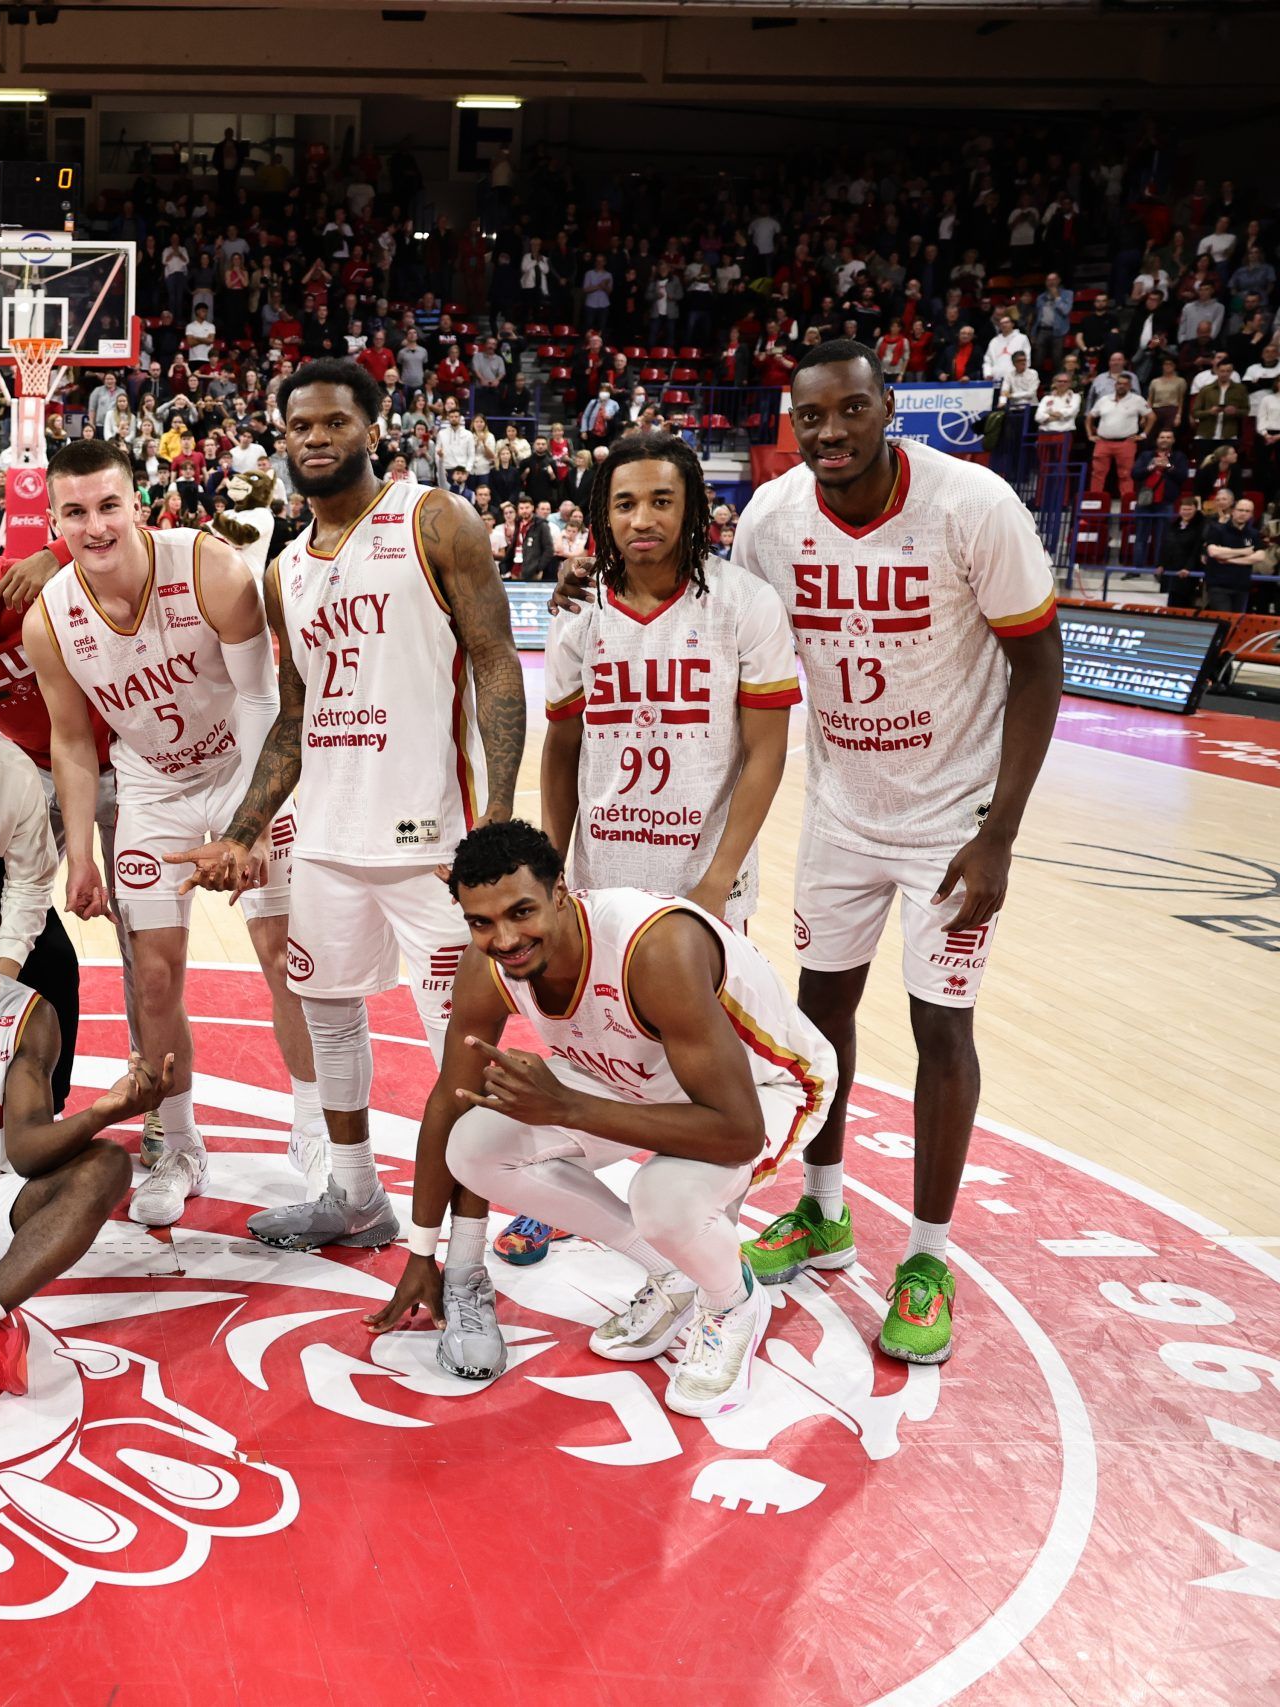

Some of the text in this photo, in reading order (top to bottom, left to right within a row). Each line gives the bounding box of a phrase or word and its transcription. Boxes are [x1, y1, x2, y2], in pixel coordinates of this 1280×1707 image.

[58, 168, 73, 189] 0
[895, 395, 963, 409] utuelles
[792, 564, 930, 611] SLUC
[69, 617, 89, 628] errea
[73, 636, 96, 648] CRÉA
[76, 644, 98, 655] STONE
[93, 651, 199, 713] NANCY
[322, 647, 360, 699] 25
[588, 659, 710, 705] SLUC
[835, 656, 887, 706] 13
[153, 702, 185, 743] 5
[818, 708, 931, 733] métropole
[823, 726, 933, 752] GrandNancy
[618, 746, 671, 795] 99
[589, 803, 702, 829] métropole
[396, 835, 419, 844] errea
[590, 824, 701, 850] GrandNancy
[118, 861, 157, 876] cora
[287, 953, 310, 972] ora
[943, 986, 967, 996] errea
